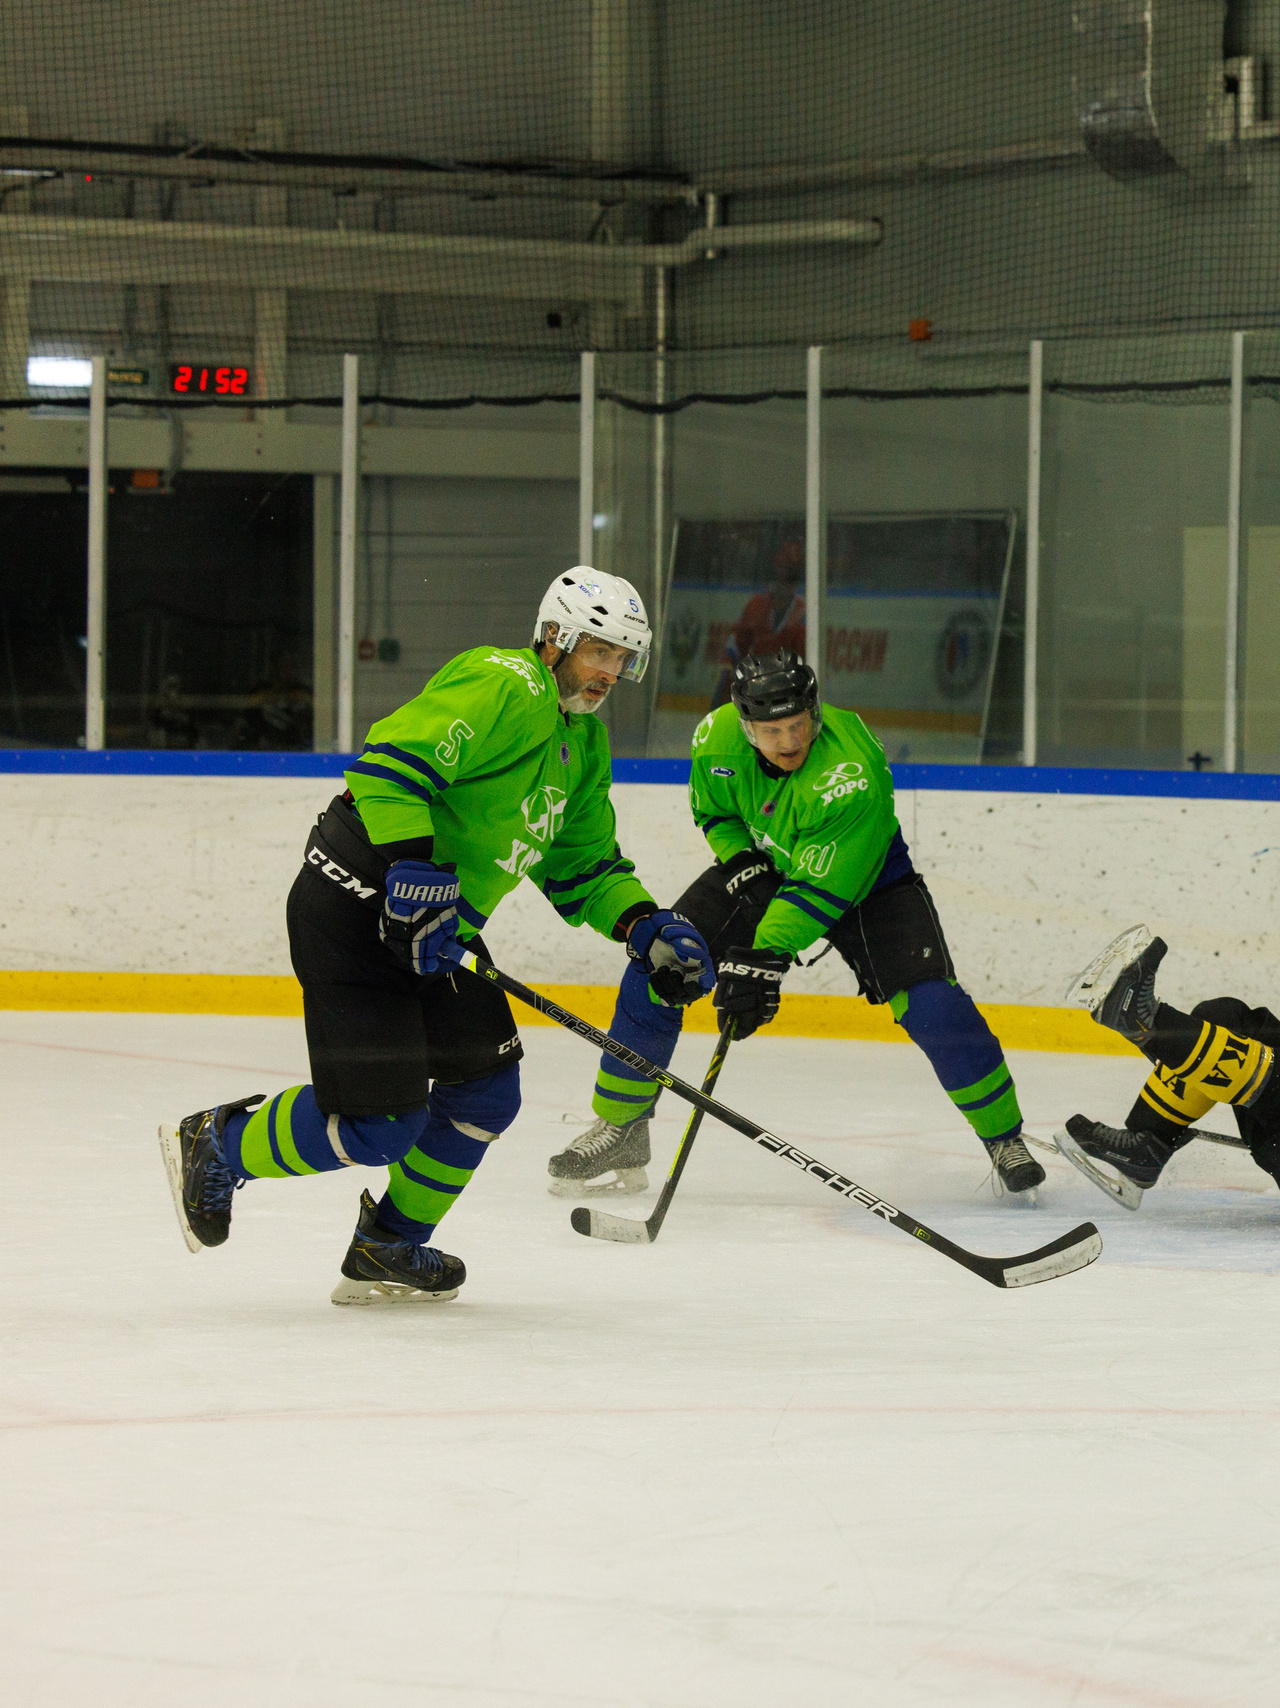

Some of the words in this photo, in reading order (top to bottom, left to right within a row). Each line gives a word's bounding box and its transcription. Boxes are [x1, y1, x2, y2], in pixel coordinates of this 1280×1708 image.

[557, 596, 573, 615] EASTON
[624, 614, 646, 625] EASTON
[629, 598, 639, 613] 5
[435, 719, 475, 767] 5
[307, 845, 378, 900] CCM
[725, 862, 769, 895] STON
[752, 1131, 900, 1221] FISCHER
